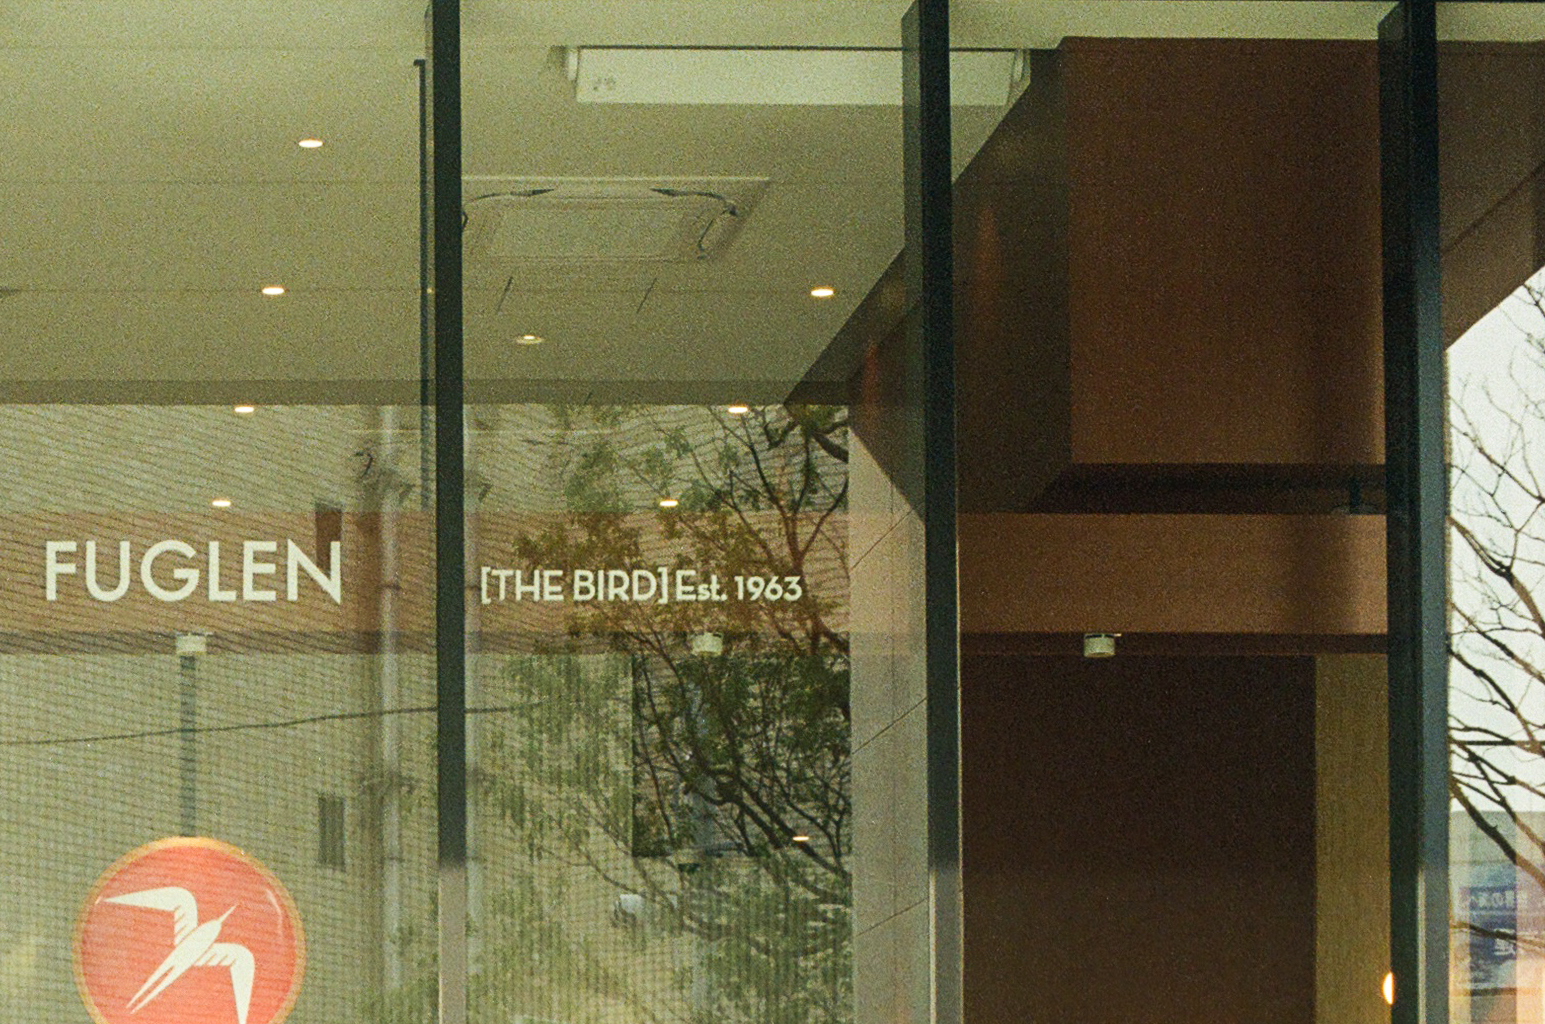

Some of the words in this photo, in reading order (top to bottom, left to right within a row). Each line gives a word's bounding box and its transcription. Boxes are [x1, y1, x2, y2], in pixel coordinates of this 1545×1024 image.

[45, 538, 341, 605] FUGLEN
[480, 566, 564, 605] [THE
[572, 566, 669, 605] BIRD]
[675, 569, 727, 602] Est.
[733, 575, 803, 602] 1963
